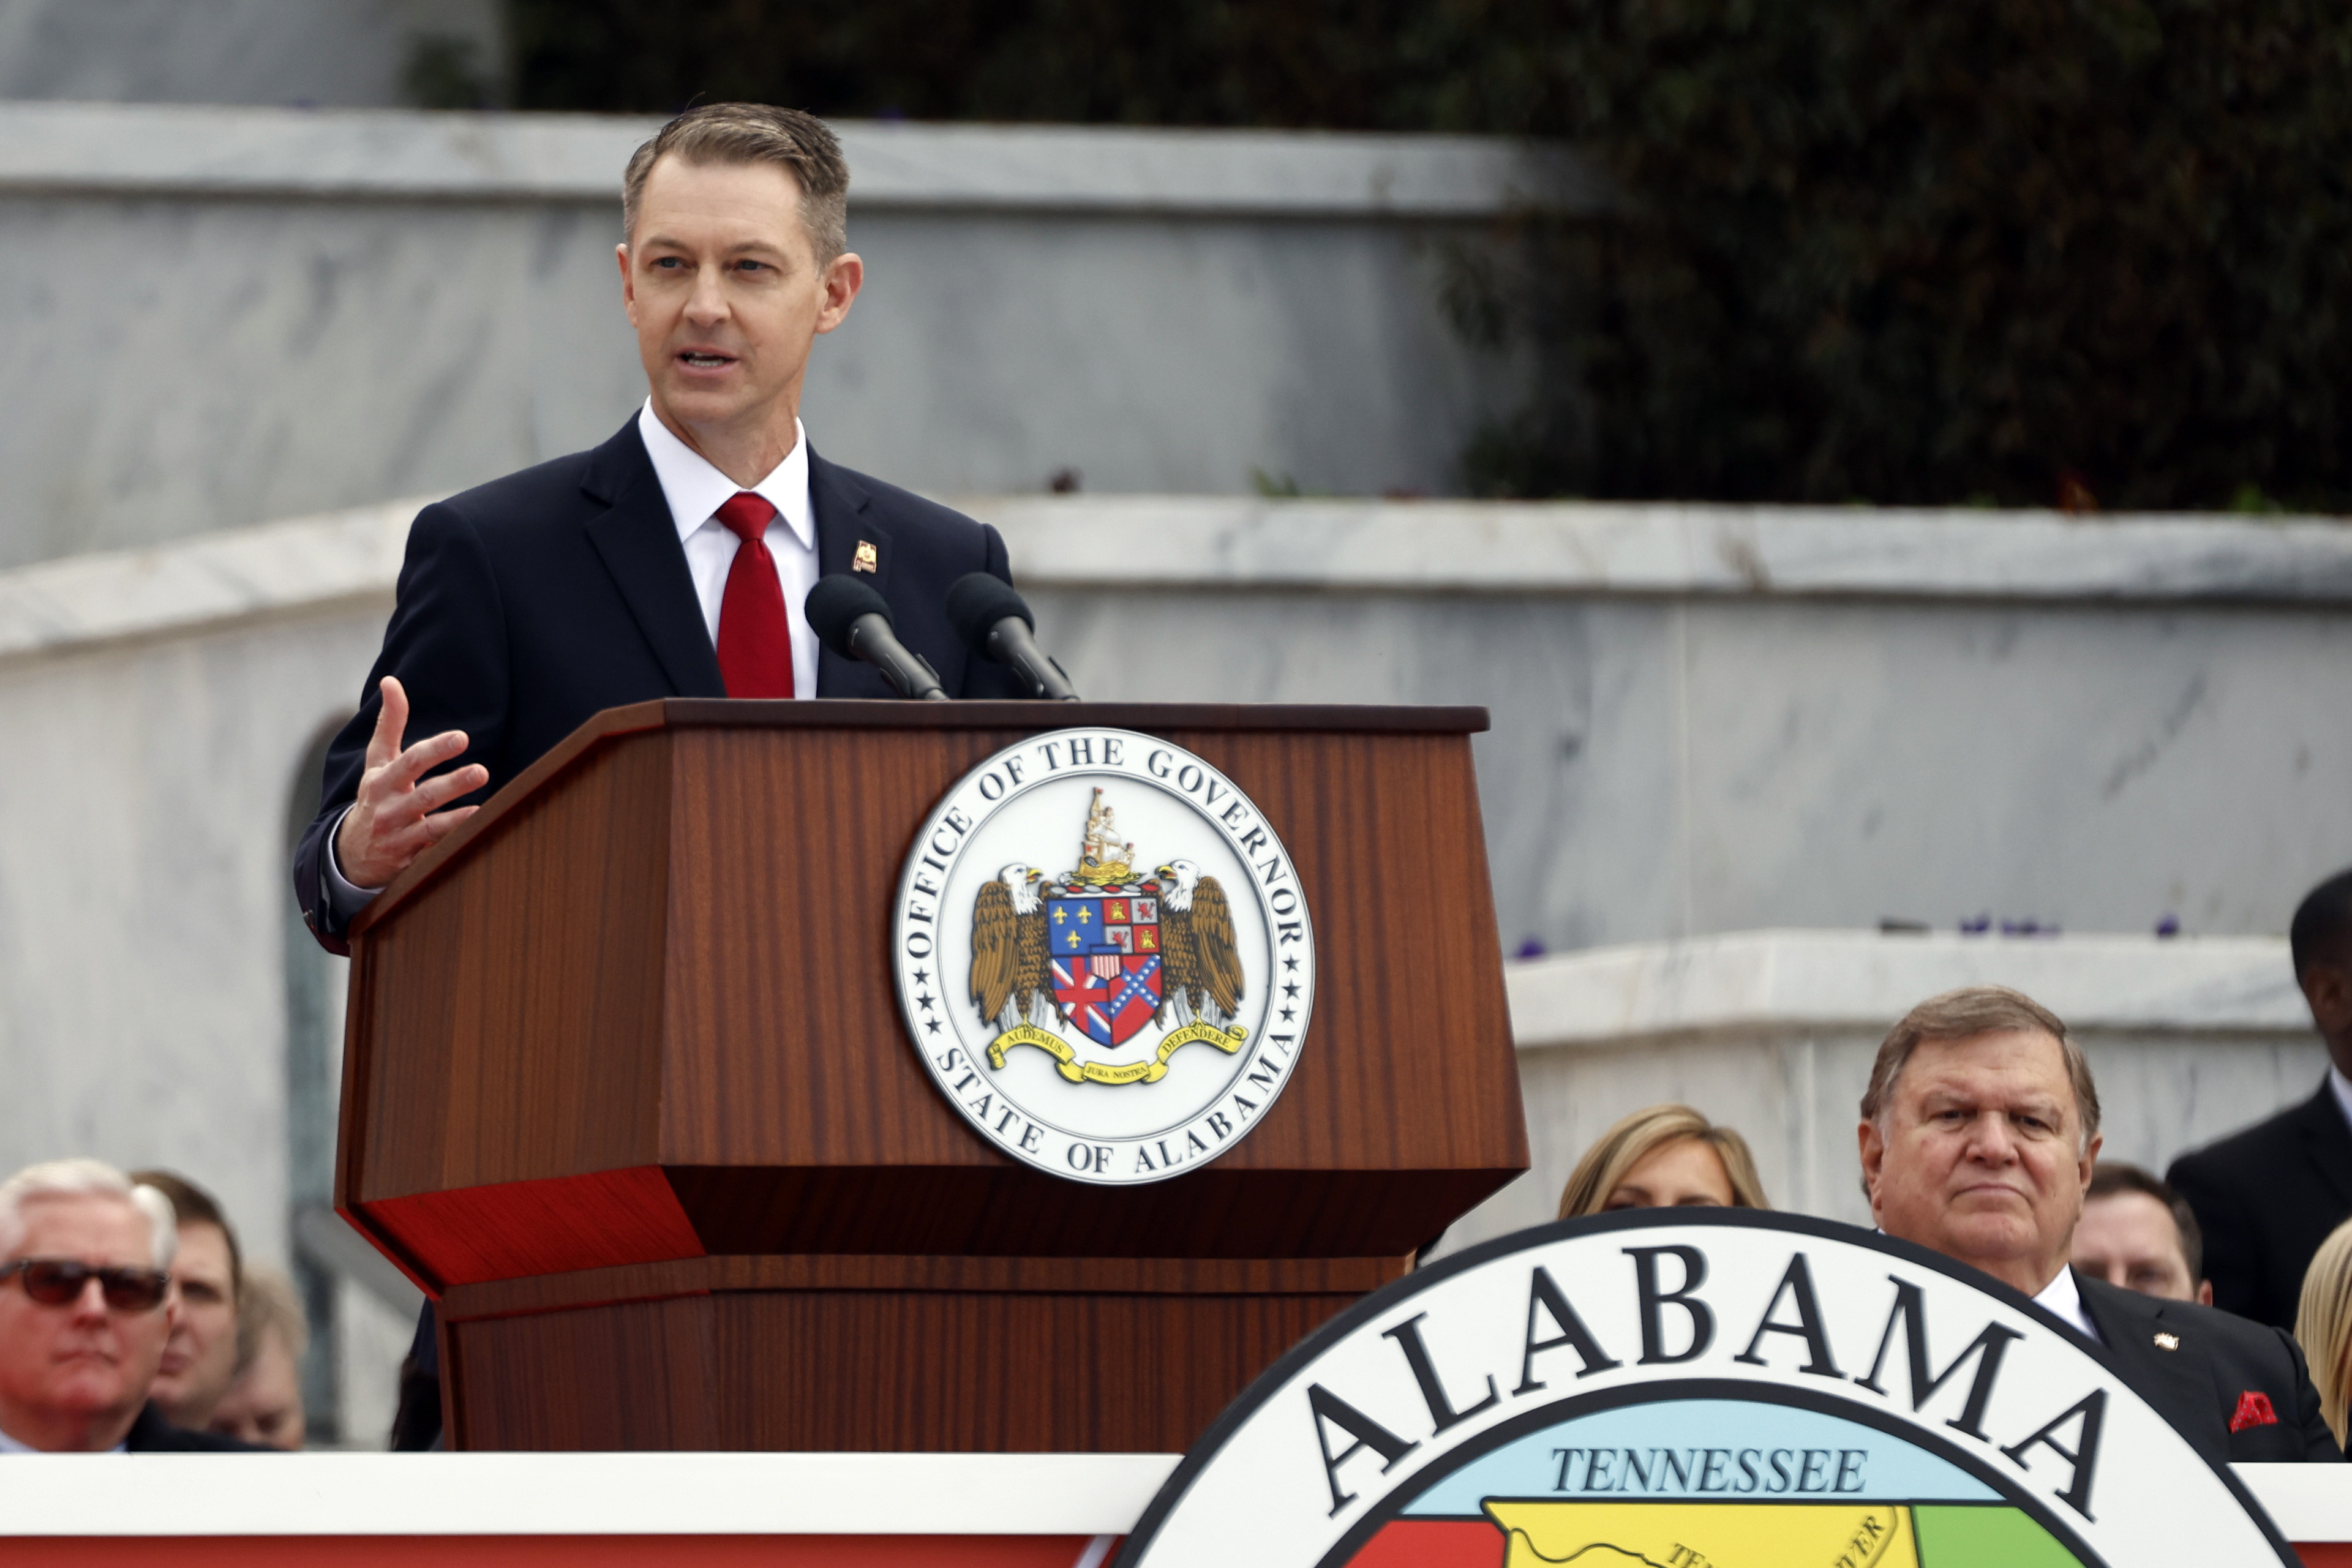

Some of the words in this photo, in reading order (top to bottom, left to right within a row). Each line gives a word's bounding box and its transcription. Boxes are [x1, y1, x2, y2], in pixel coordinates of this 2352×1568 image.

[907, 806, 973, 958] OFFICE
[979, 755, 1027, 801] OF
[1039, 737, 1124, 771] THE
[1148, 748, 1303, 945] GOVERNOR
[1007, 1029, 1064, 1054] AUDEMUS
[1162, 1027, 1231, 1054] DEFENDERE
[1113, 1066, 1146, 1078] NOSTRA
[936, 1047, 1045, 1155] STATE
[1067, 1142, 1113, 1172] OF
[1134, 1031, 1296, 1173] ALABAMA
[1307, 1243, 2110, 1524] ALABAMA
[1552, 1447, 1869, 1493] TENNESSEE
